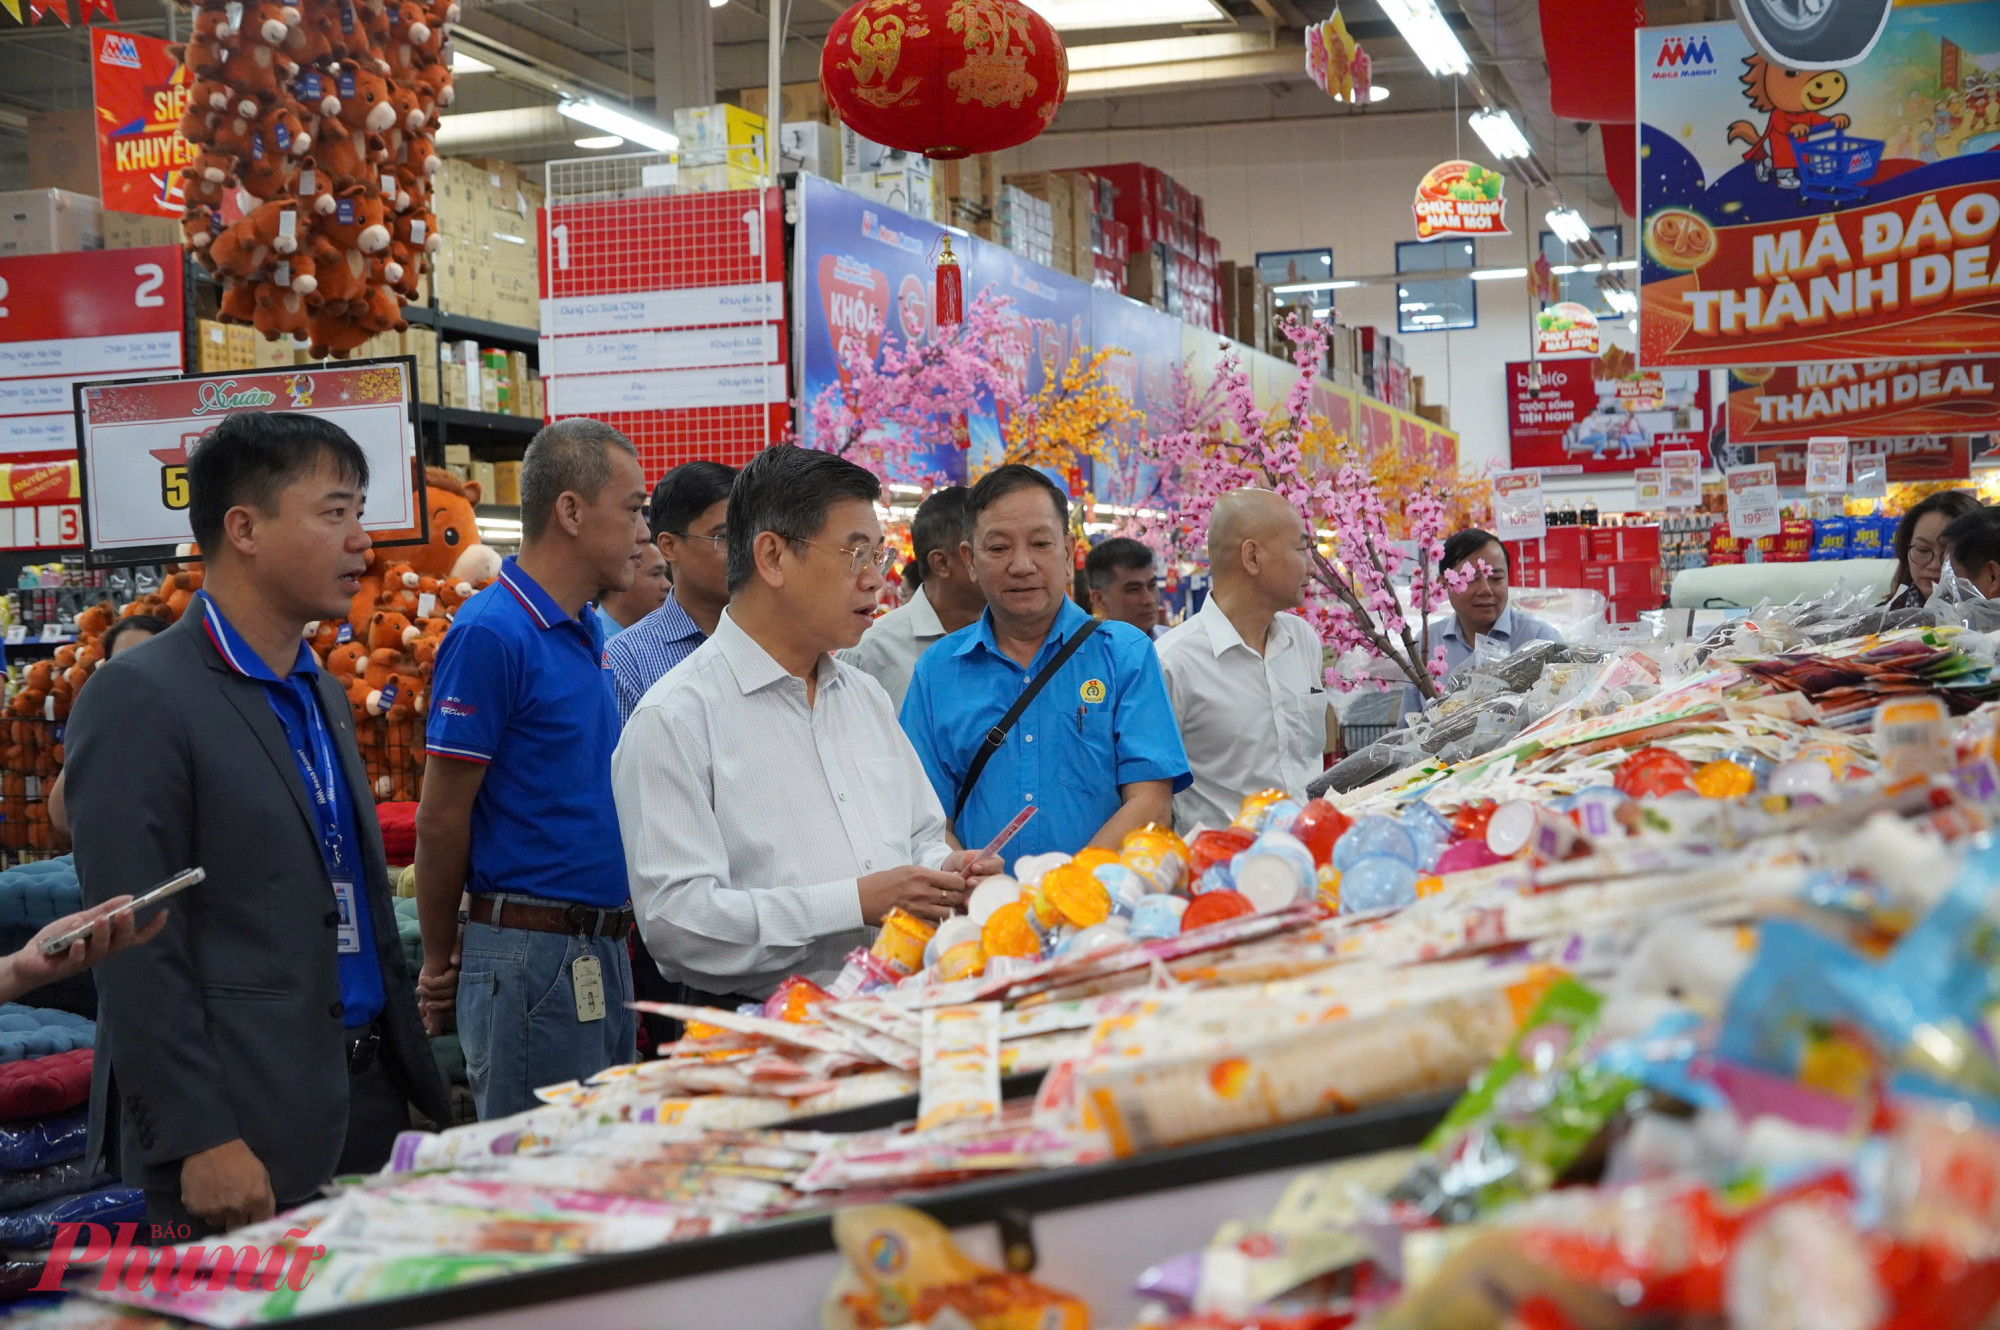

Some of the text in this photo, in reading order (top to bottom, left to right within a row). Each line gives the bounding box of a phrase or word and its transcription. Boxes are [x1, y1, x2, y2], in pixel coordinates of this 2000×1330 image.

[552, 224, 568, 270] 1
[742, 209, 759, 256] 1
[134, 263, 164, 308] 2
[1683, 245, 2000, 333] THÀNH DE
[1893, 364, 1995, 402] DEAL
[62, 508, 78, 541] 3
